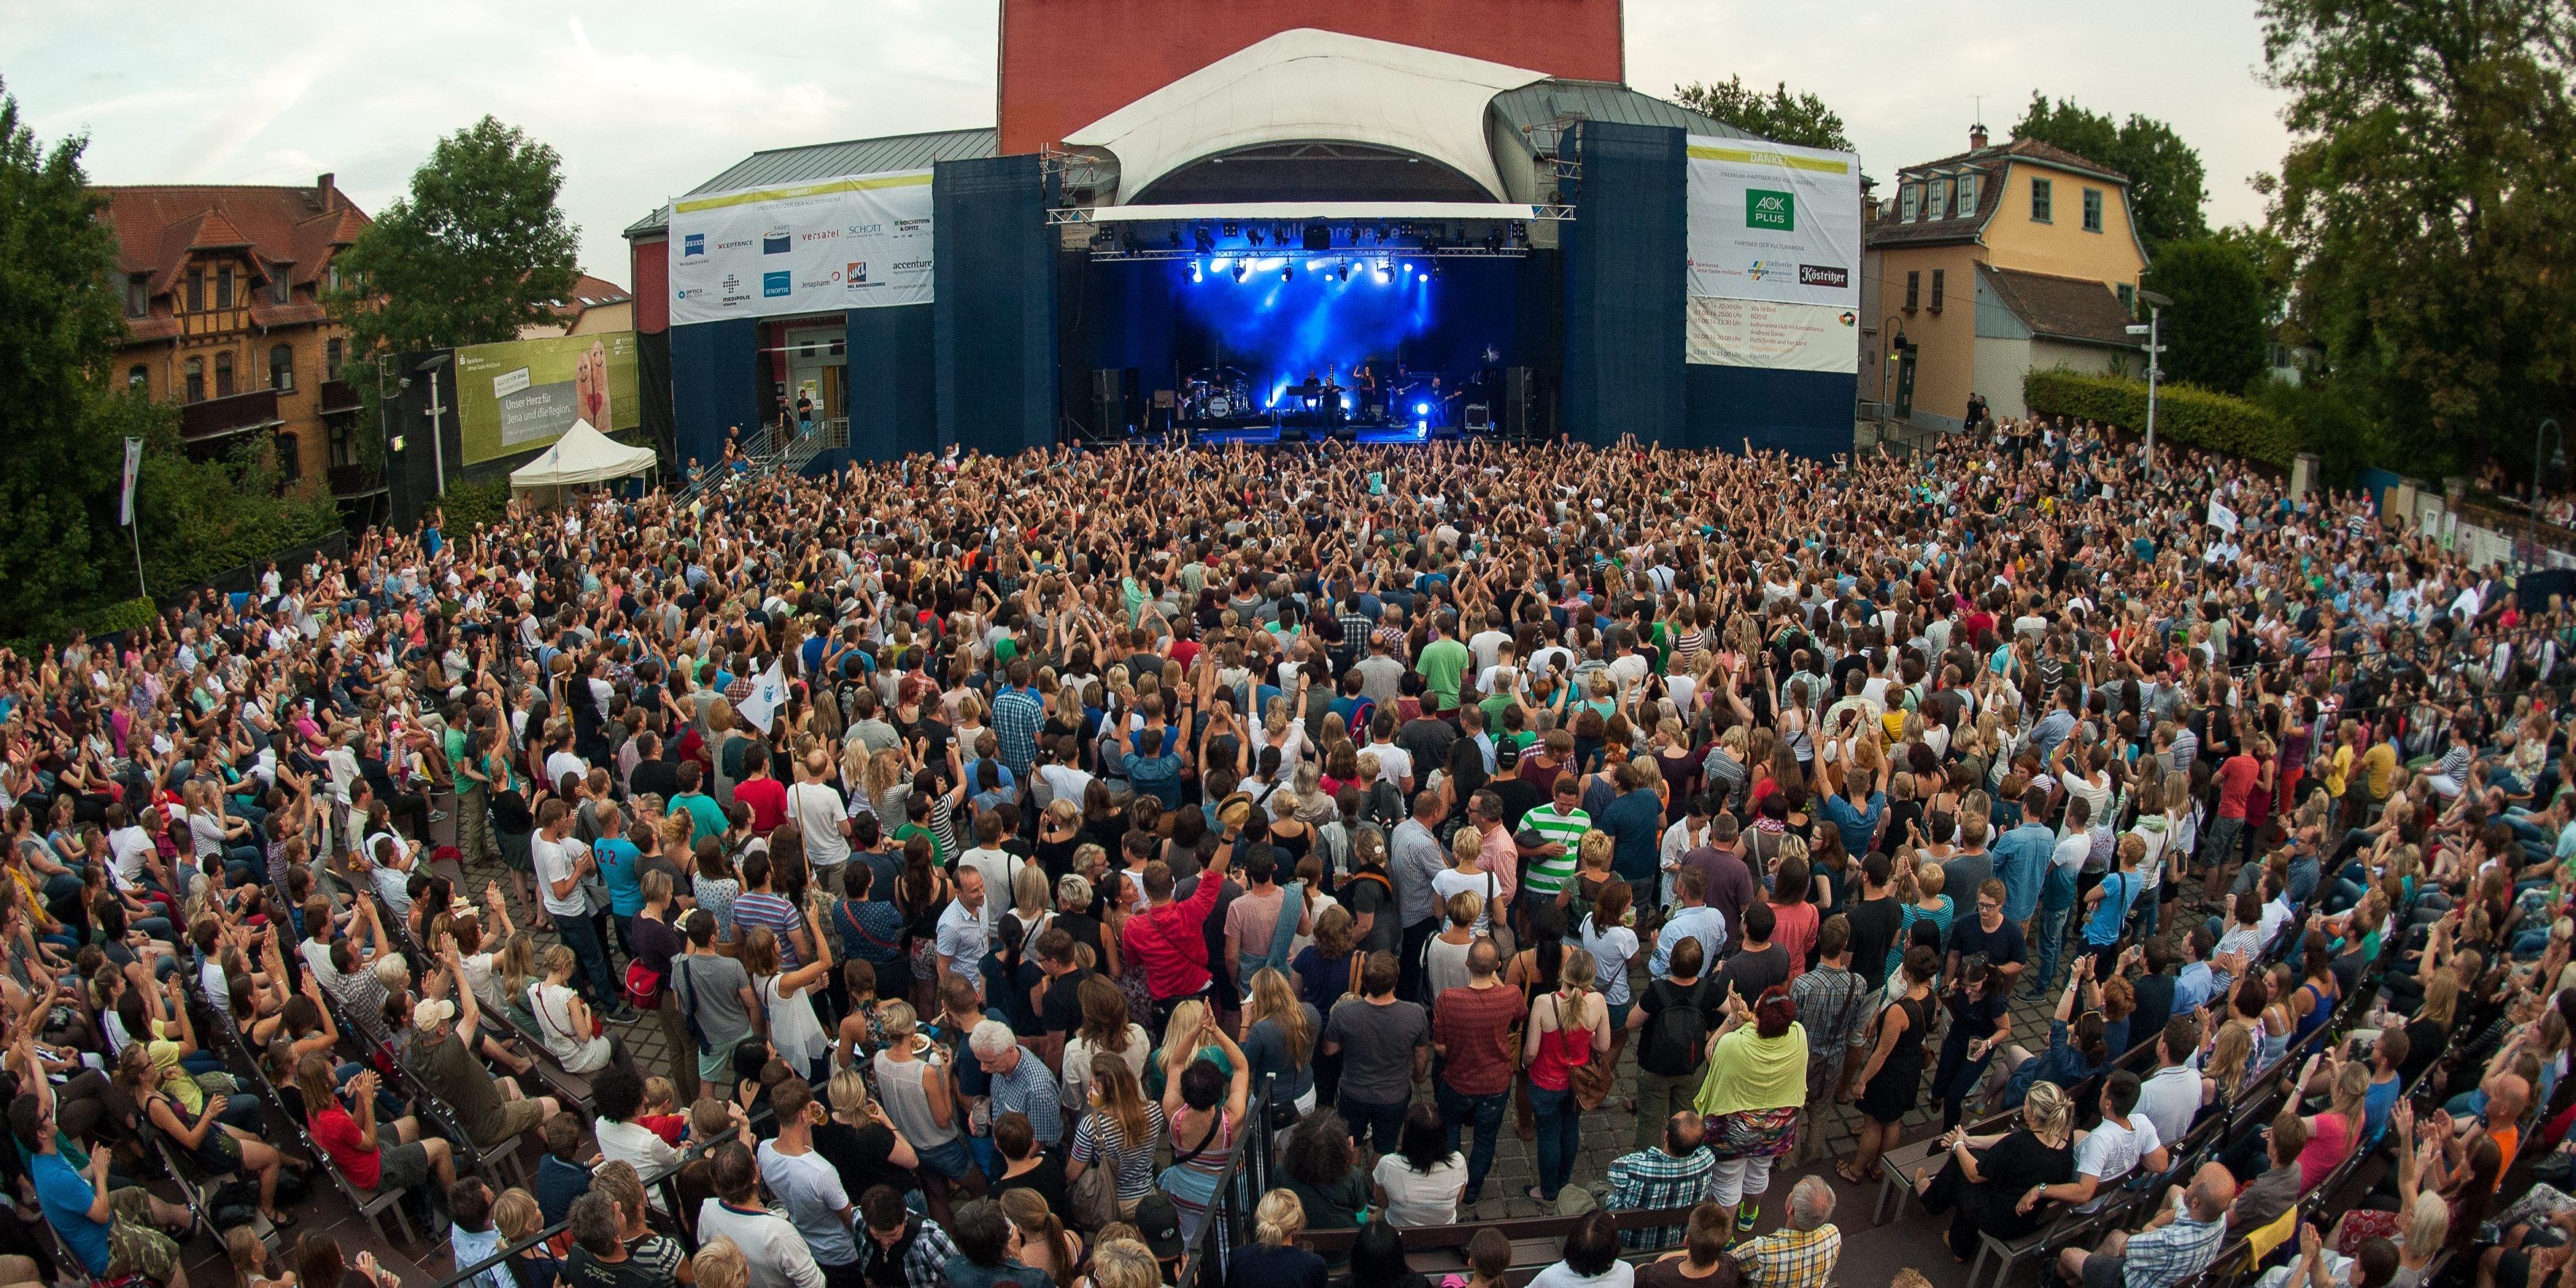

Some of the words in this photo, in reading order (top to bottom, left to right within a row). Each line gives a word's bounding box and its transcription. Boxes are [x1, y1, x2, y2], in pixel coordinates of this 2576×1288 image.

[1751, 152, 1787, 165] DANKE!
[1755, 197, 1784, 210] AOK
[1755, 214, 1784, 223] PLUS
[802, 229, 840, 241] versatel
[848, 224, 882, 235] SCHOTT
[686, 239, 704, 247] ZEISS
[718, 240, 753, 250] XCEPTANCE
[893, 260, 932, 270] accenture
[1765, 260, 1792, 268] stadtwerke
[849, 262, 865, 280] HKL
[1802, 267, 1845, 284] Köstritzer
[802, 280, 830, 289] Jenapharm
[506, 399, 525, 410] Unser
[526, 396, 541, 407] Herz
[542, 393, 551, 403] für
[507, 414, 523, 424] Jena
[524, 409, 536, 418] und
[537, 407, 548, 417] die
[549, 404, 571, 417] Region.
